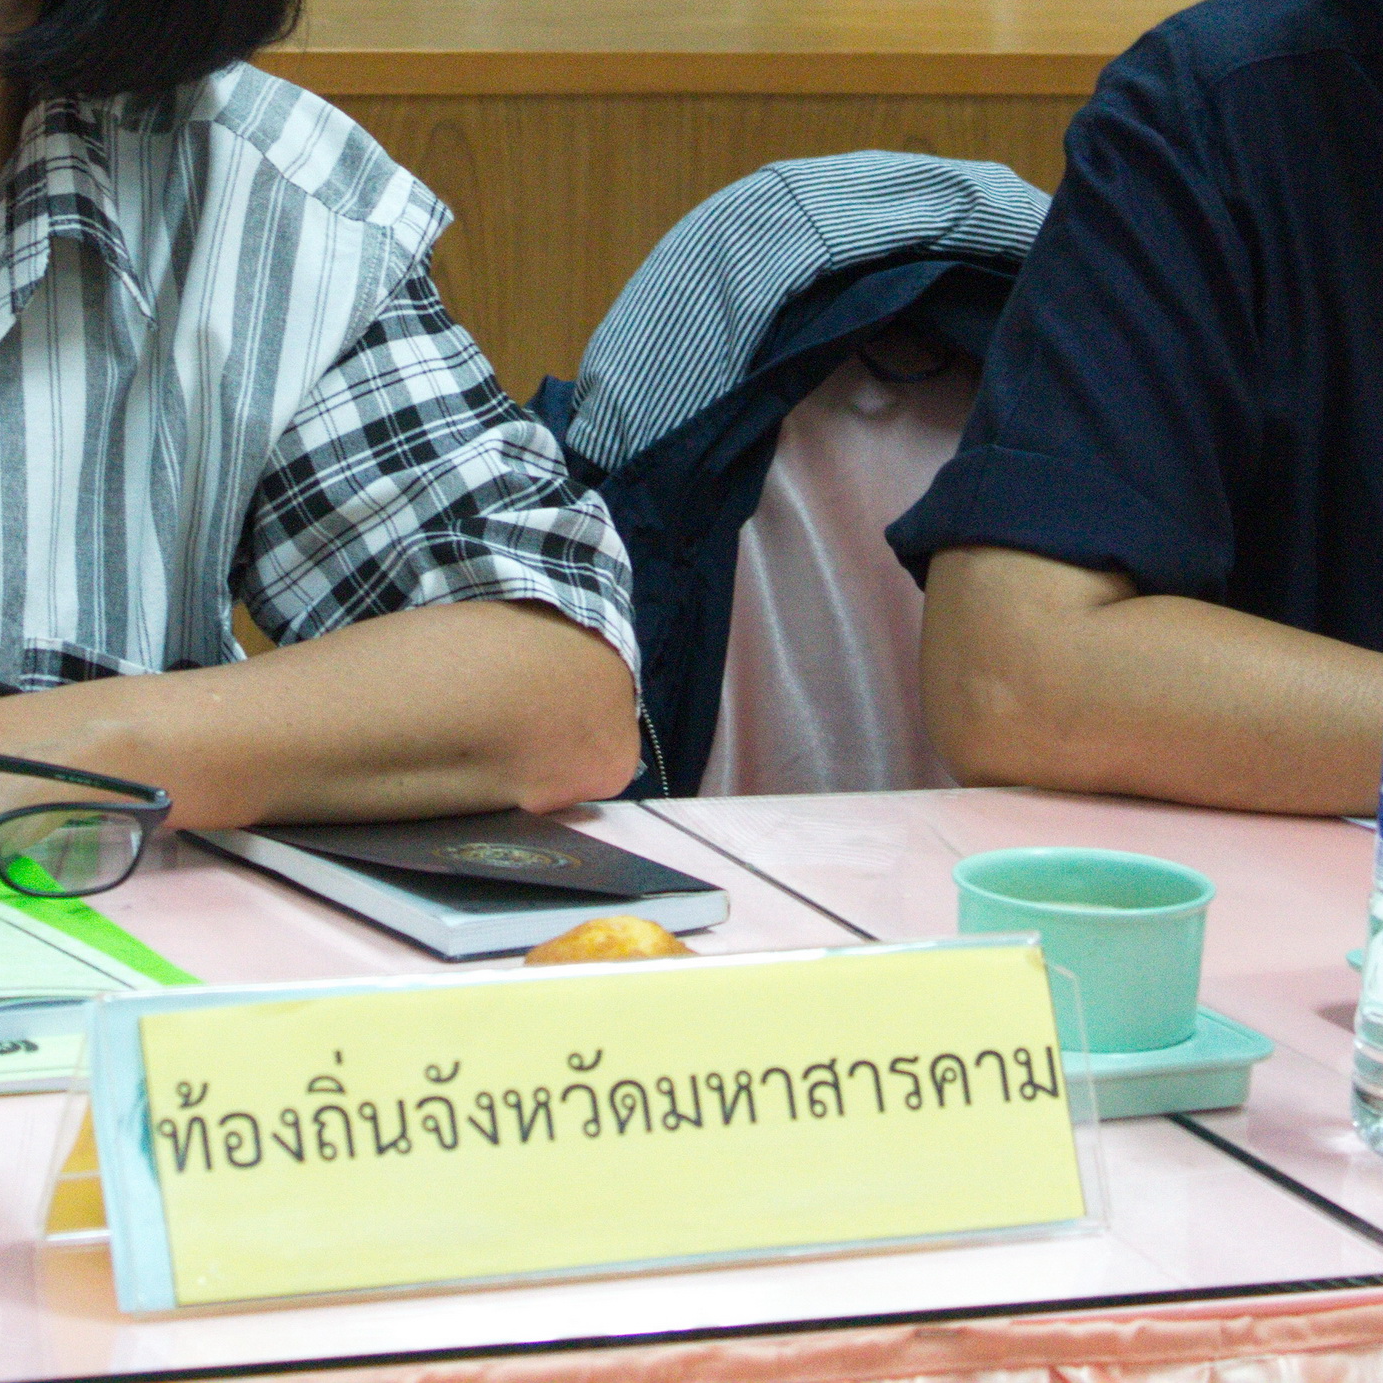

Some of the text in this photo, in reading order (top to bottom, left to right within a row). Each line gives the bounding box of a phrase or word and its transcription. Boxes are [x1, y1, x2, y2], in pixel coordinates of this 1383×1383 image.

[156, 1045, 1061, 1173] ท้องถิ่นจังหวัดมหาสารคาม
